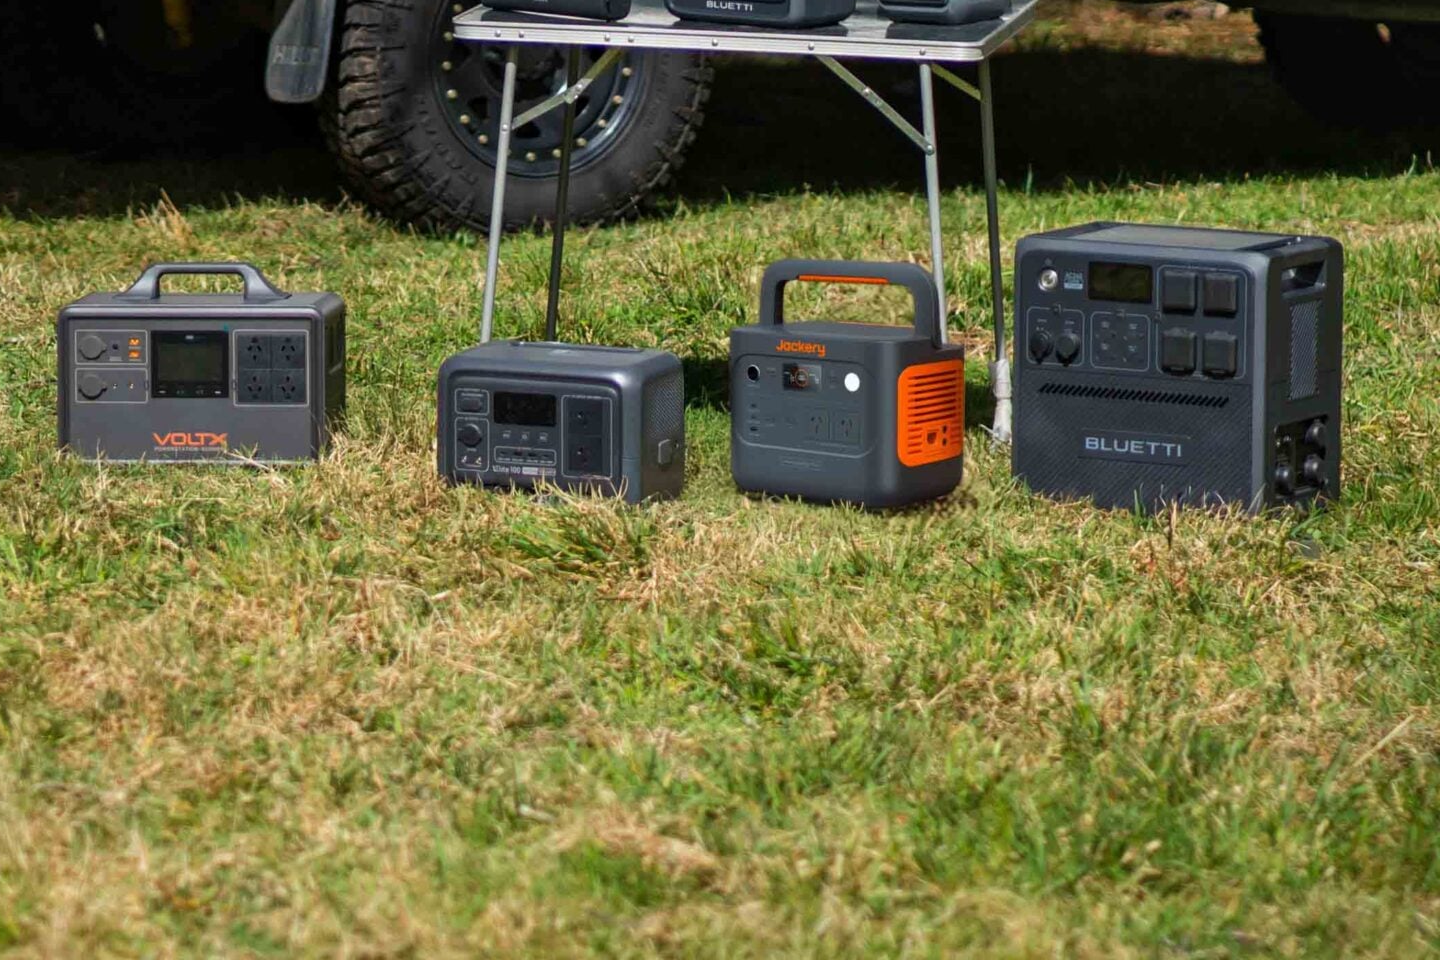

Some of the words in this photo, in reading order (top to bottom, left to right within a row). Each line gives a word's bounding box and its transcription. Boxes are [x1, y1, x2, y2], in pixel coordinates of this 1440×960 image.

[706, 0, 753, 12] BLUETTI
[776, 339, 826, 357] Jackery
[152, 432, 228, 446] VOLTX
[1085, 436, 1182, 457] BLUETTI
